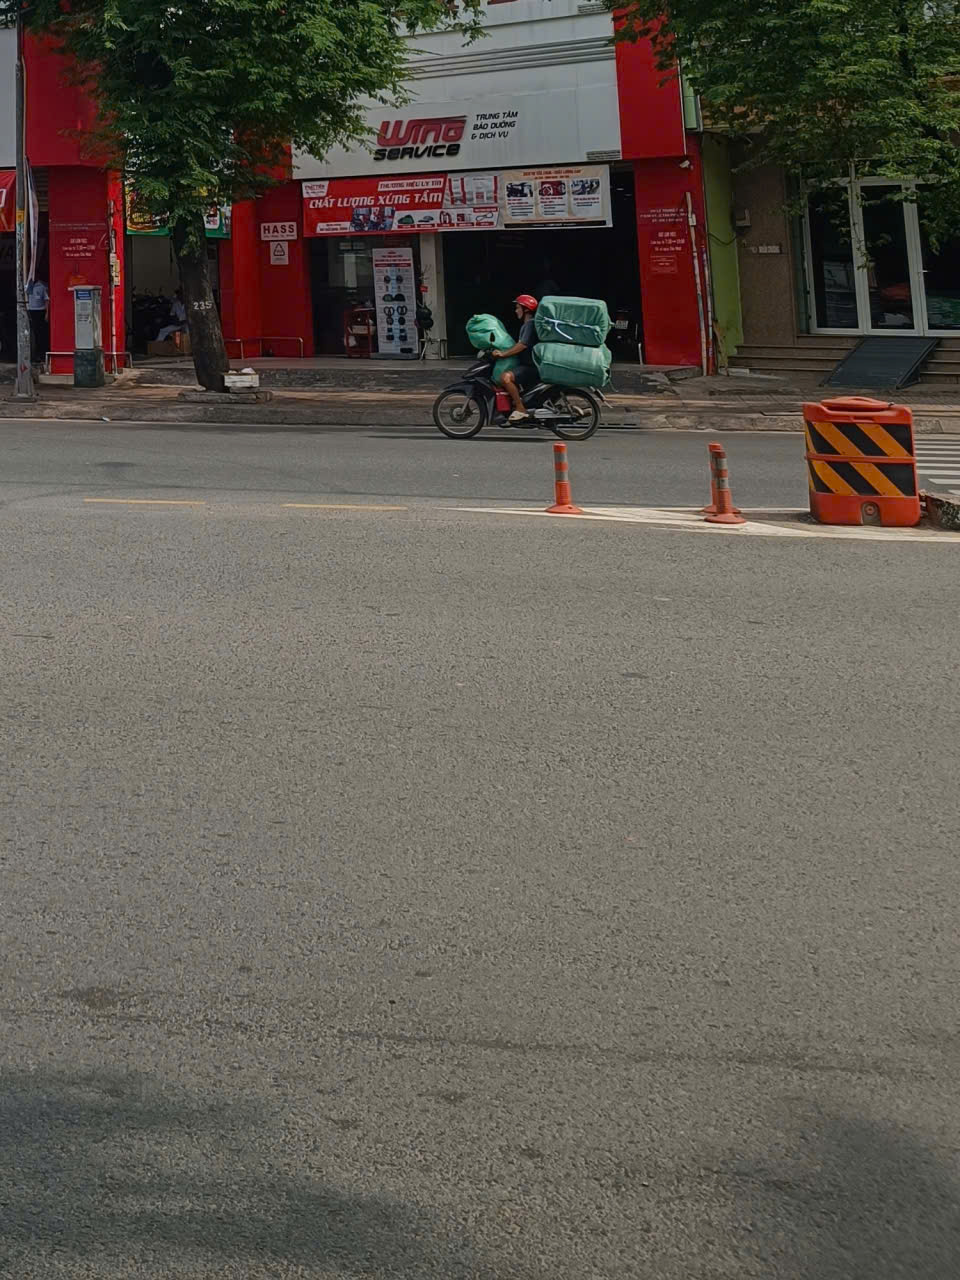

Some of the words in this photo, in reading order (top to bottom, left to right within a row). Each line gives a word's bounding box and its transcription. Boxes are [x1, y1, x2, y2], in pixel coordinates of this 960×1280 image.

[476, 113, 500, 121] TRUNG
[502, 110, 518, 120] TÂM
[479, 131, 497, 141] DỊCH
[263, 224, 294, 234] HASS
[193, 301, 212, 310] 235
